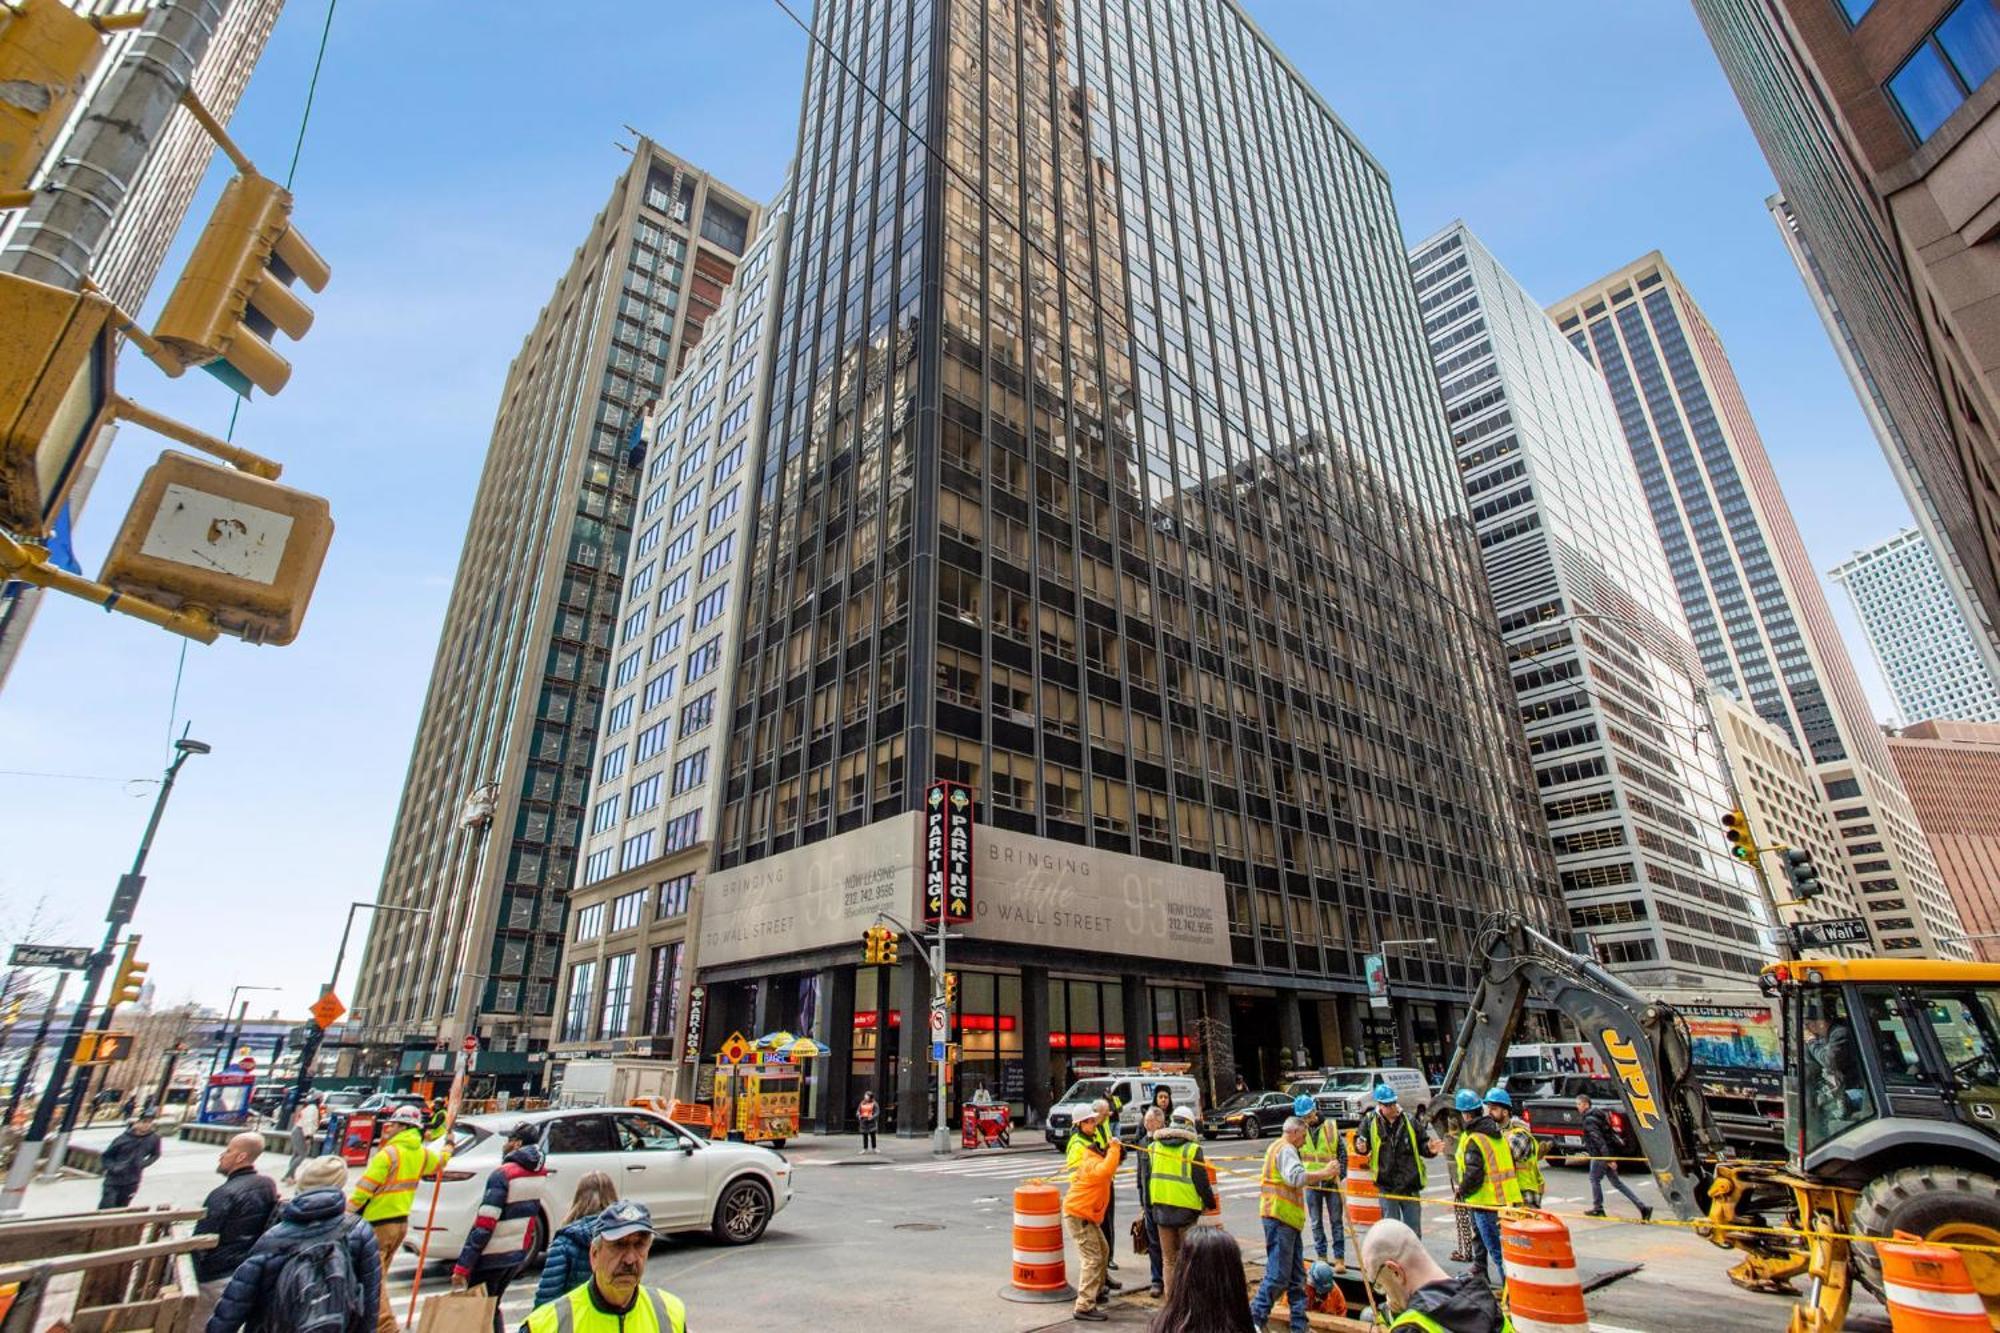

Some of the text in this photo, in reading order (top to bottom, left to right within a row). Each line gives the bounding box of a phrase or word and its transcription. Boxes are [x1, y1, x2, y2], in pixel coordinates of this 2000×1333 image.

[928, 813, 943, 896] PARKING
[950, 814, 968, 898] PARKING
[989, 844, 1090, 876] BRINGING
[722, 869, 784, 898] BRINGING
[999, 904, 1046, 925] WALL
[1053, 911, 1112, 933] STREET
[1123, 873, 1168, 938] 95
[706, 916, 794, 946] TO WALL STREET
[1825, 927, 1855, 940] Wall
[686, 1001, 702, 1047] PARKING
